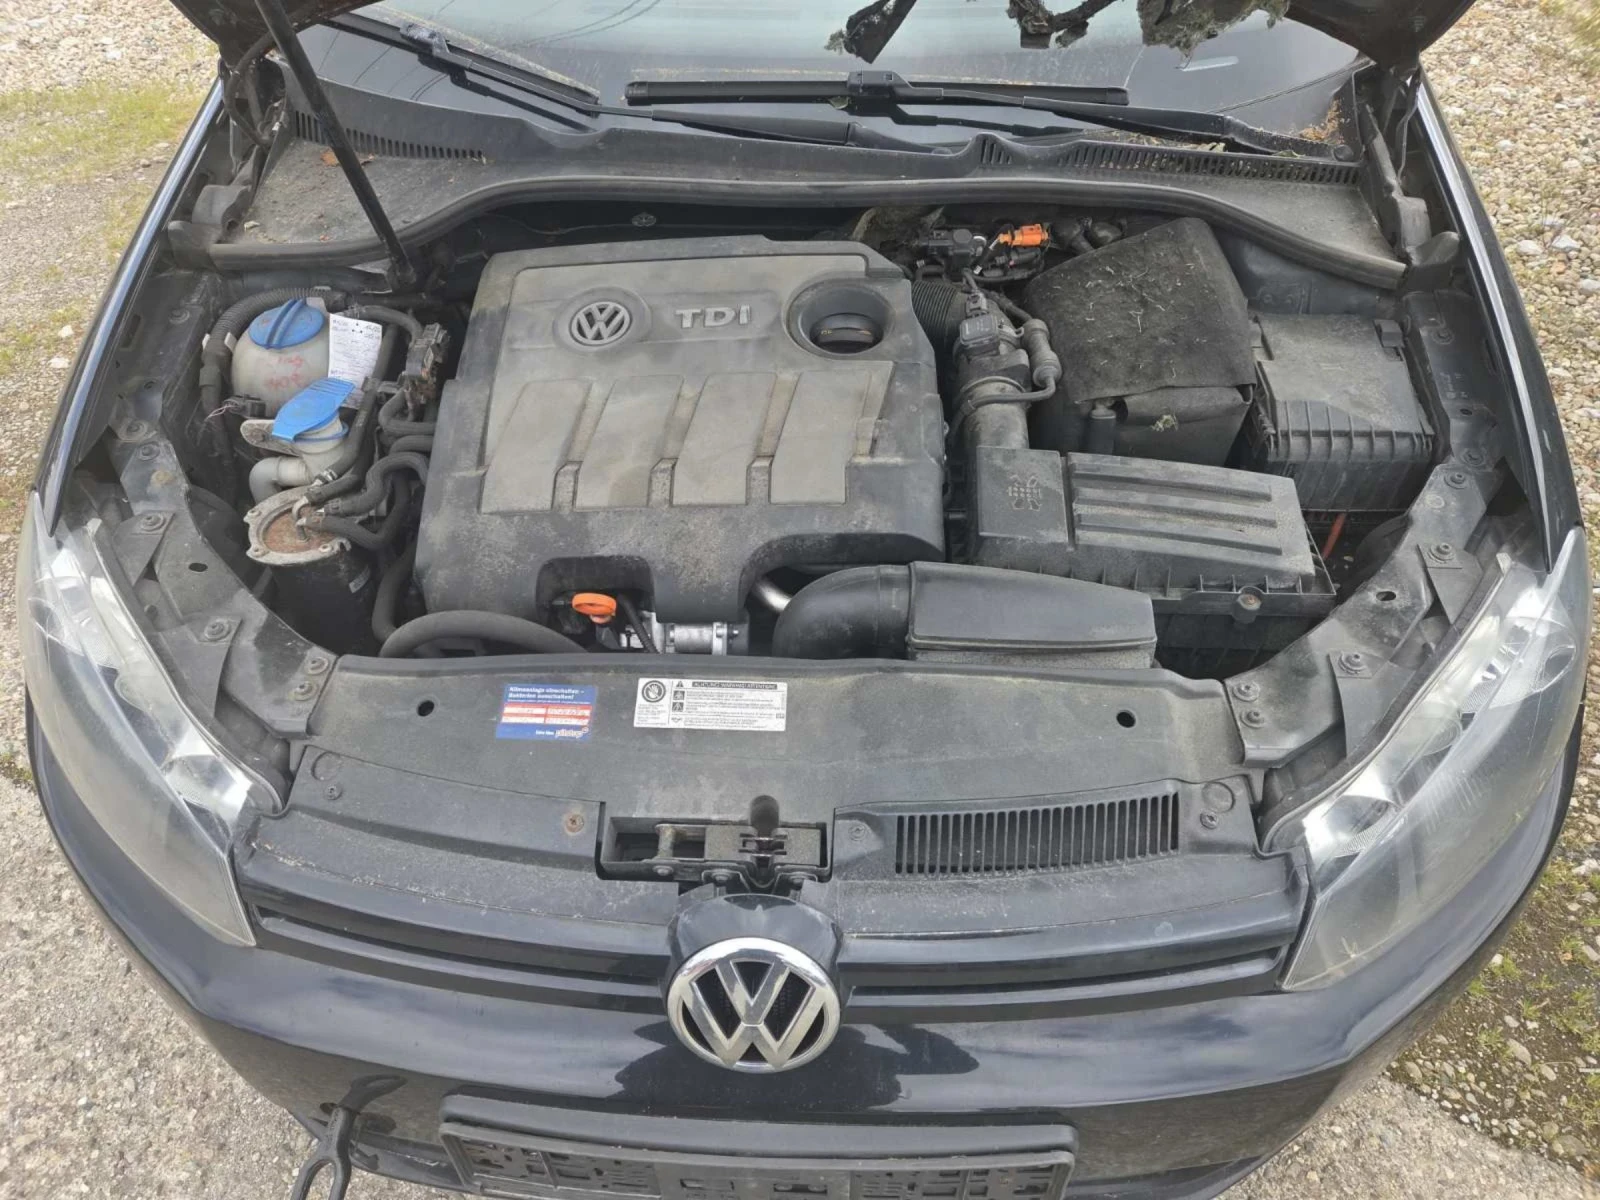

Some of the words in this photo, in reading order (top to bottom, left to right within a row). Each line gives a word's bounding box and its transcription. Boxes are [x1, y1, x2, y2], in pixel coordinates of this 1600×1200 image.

[572, 302, 630, 344] VW
[675, 304, 750, 328] TDI
[670, 940, 837, 1073] VW
